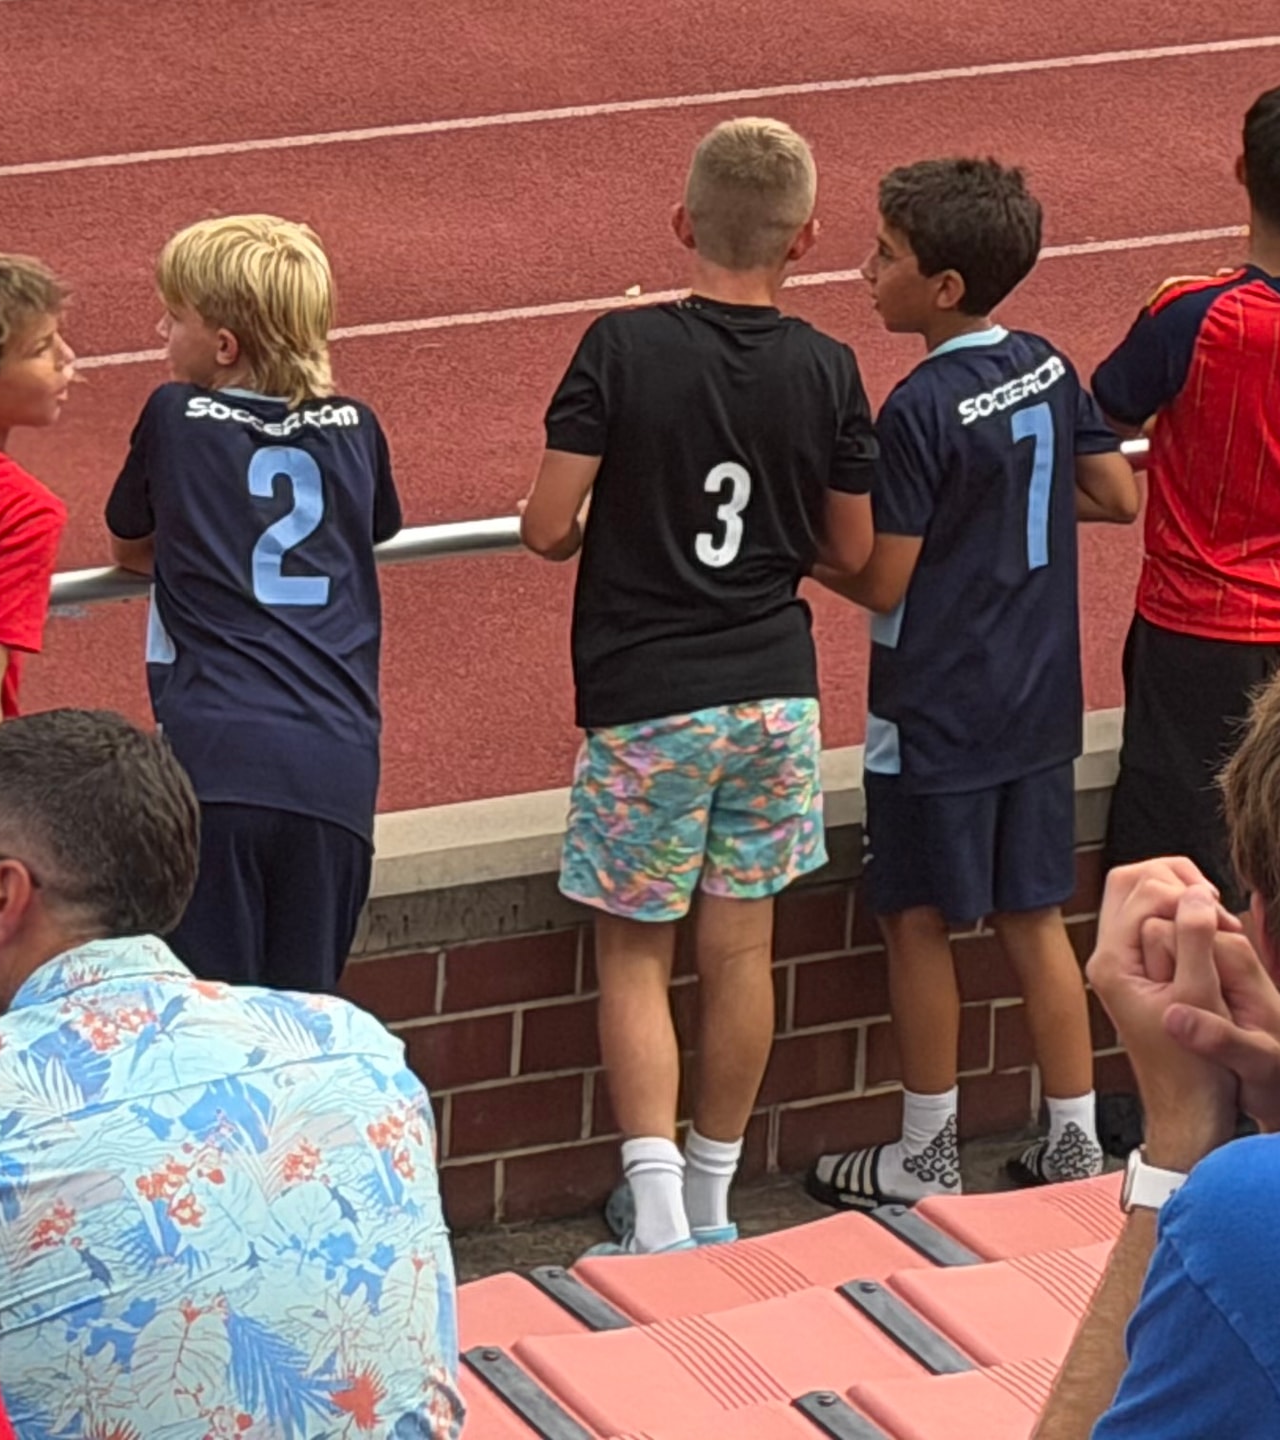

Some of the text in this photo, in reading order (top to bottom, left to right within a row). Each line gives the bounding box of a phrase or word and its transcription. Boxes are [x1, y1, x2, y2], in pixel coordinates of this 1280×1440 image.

[248, 446, 330, 606] 2
[694, 462, 752, 567] 3
[1011, 401, 1054, 571] 7
